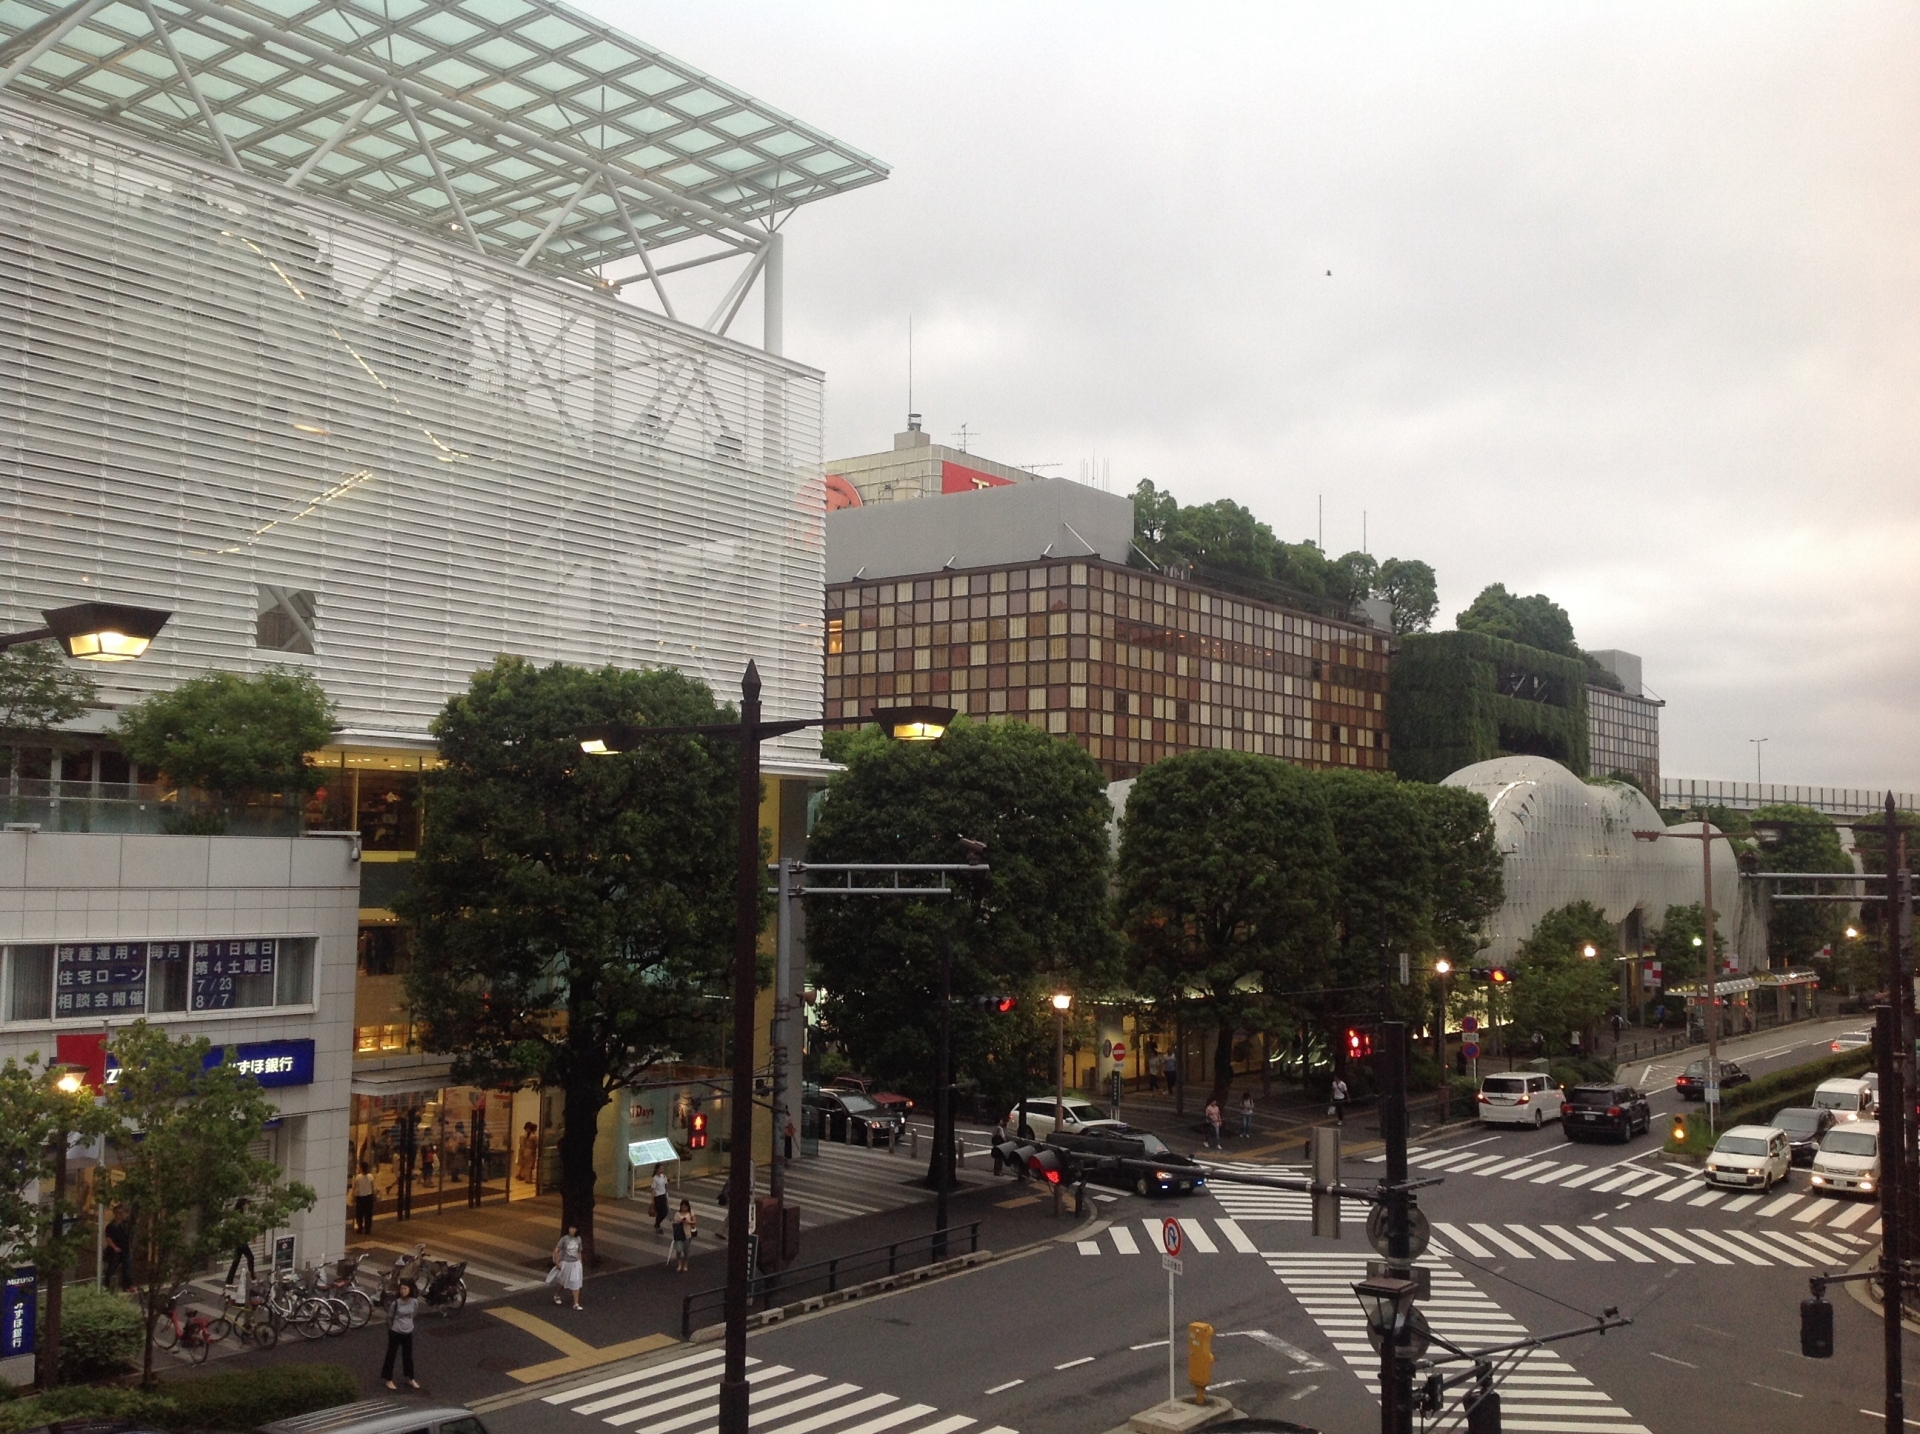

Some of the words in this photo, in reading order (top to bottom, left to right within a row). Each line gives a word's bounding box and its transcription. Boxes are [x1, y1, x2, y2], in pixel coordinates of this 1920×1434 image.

[151, 944, 180, 959] 毎月
[59, 969, 144, 986] 住宅ローン
[58, 991, 144, 1009] 相談会開催
[224, 1057, 293, 1075] ずほ銀行
